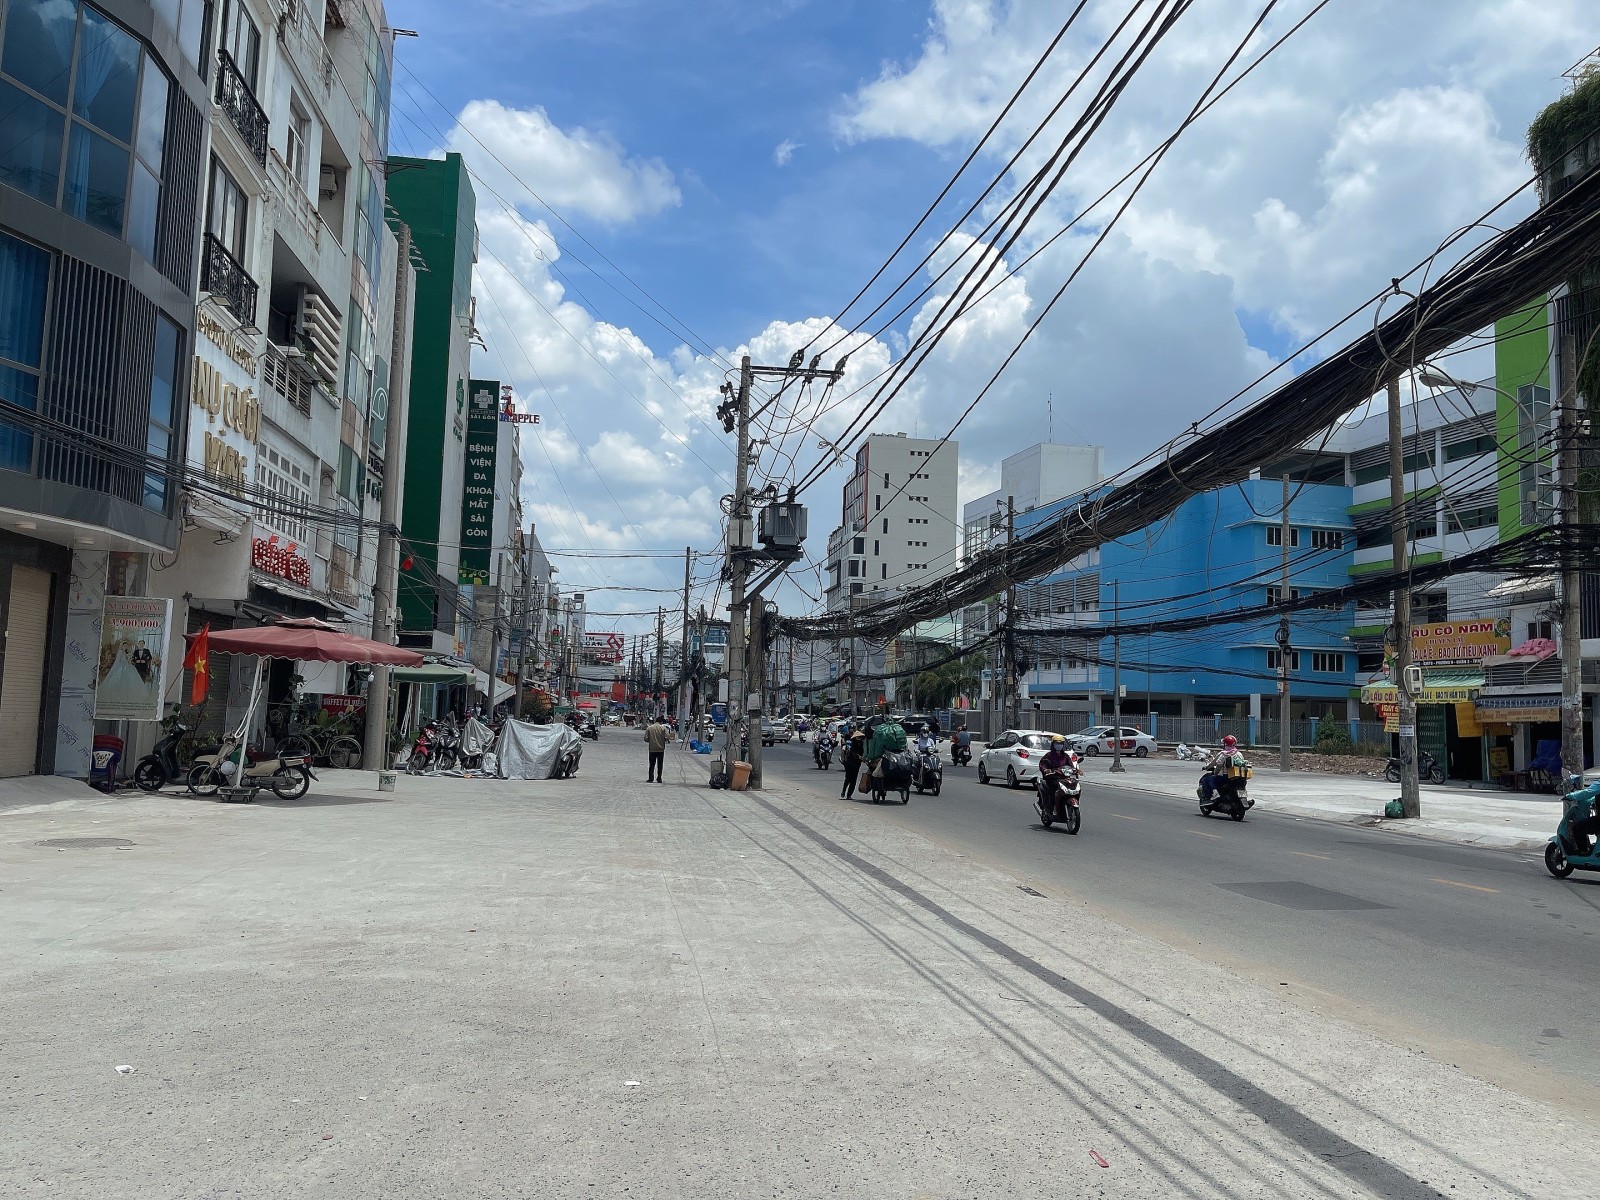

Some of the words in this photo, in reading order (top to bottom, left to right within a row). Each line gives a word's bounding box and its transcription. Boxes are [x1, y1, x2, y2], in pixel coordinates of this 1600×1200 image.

[469, 443, 494, 453] BỆNH
[470, 457, 491, 467] VIỆN
[473, 472, 487, 480] ĐA
[466, 486, 493, 495] KHOA
[469, 498, 489, 509] MẮT
[470, 513, 485, 522] SÀI
[466, 527, 488, 537] GÒN
[110, 618, 160, 628] 3.900.000
[1411, 626, 1429, 638] ẨU
[1458, 623, 1494, 633] NĂM
[1438, 647, 1451, 659] BAO
[1463, 643, 1477, 657] TIÊU
[1478, 644, 1497, 657] XANH
